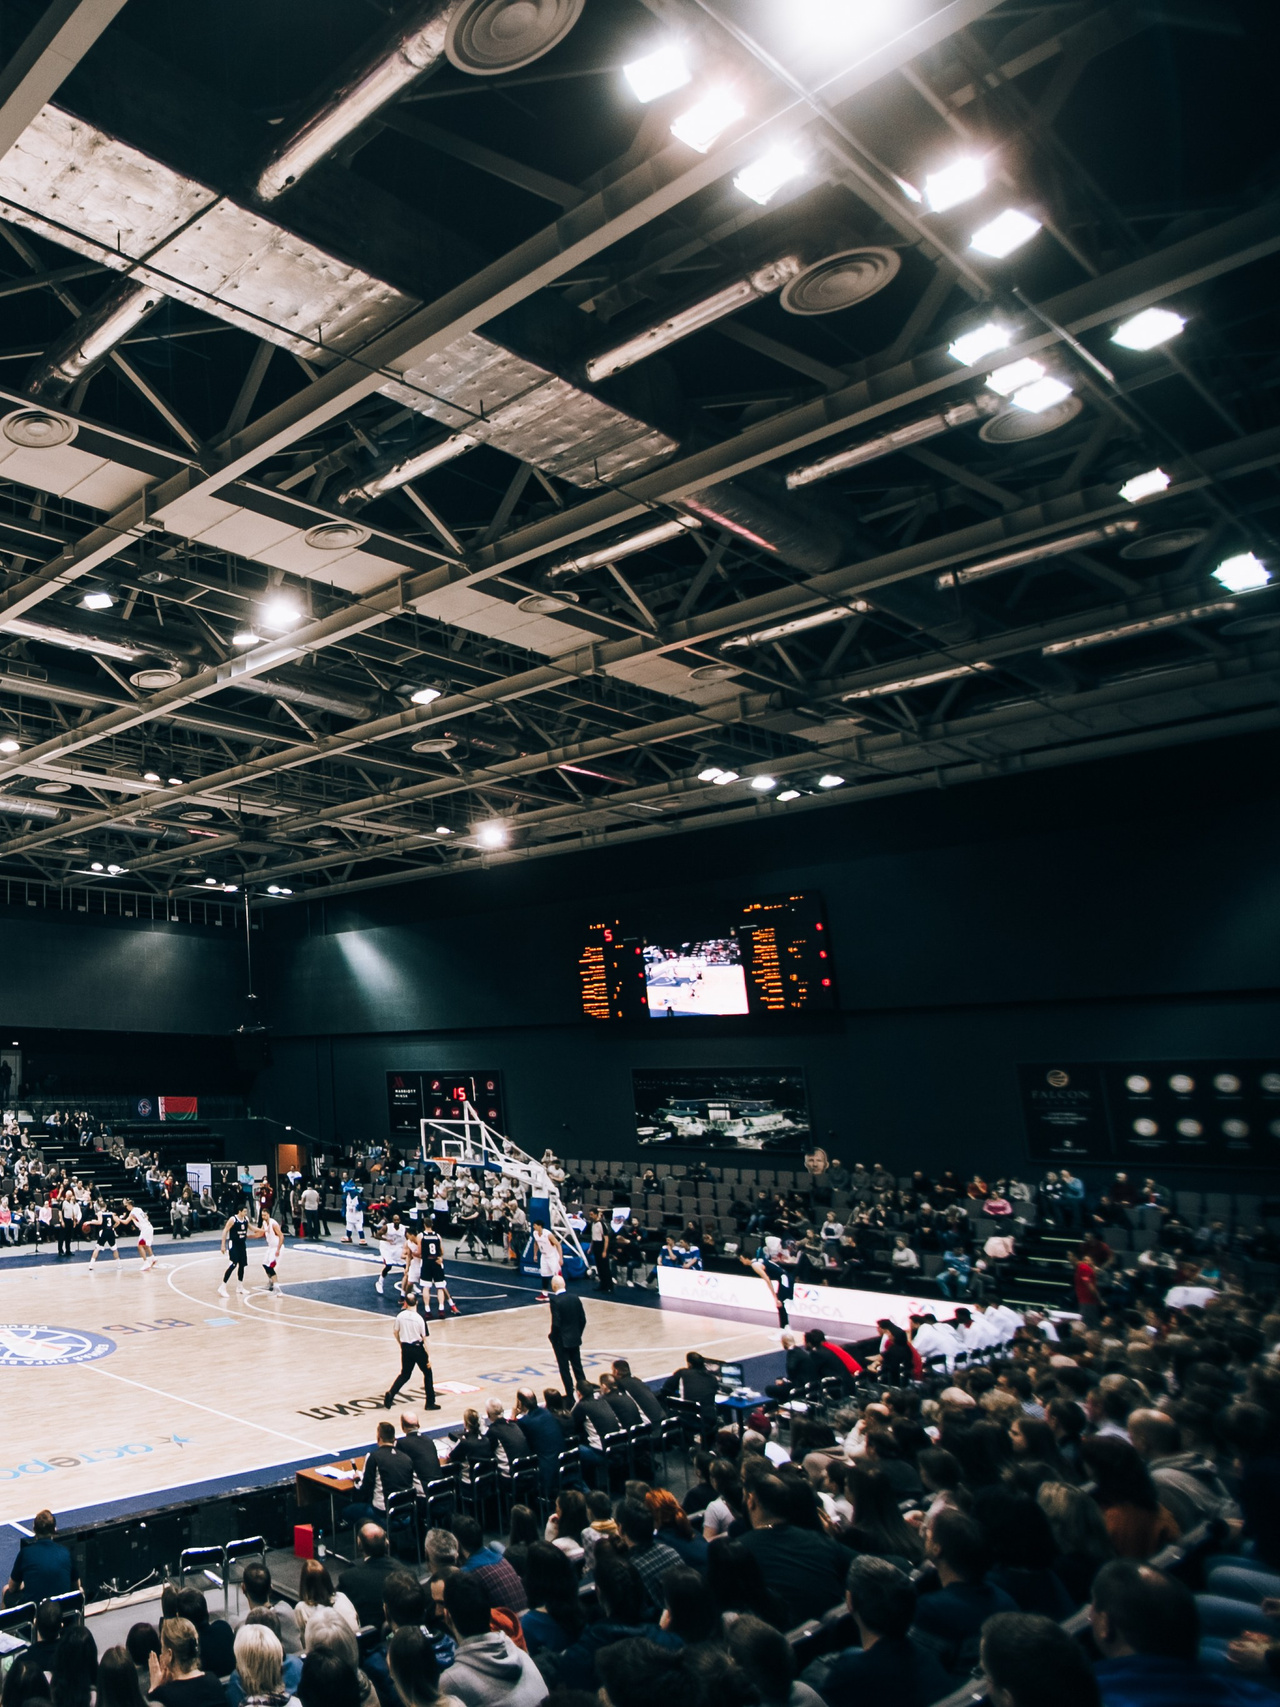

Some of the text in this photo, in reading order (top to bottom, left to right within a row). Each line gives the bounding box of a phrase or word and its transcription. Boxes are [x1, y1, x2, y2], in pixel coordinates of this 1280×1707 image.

[453, 1087, 466, 1101] 15
[1031, 1090, 1090, 1099] FALCON
[102, 1318, 195, 1335] ВТБ
